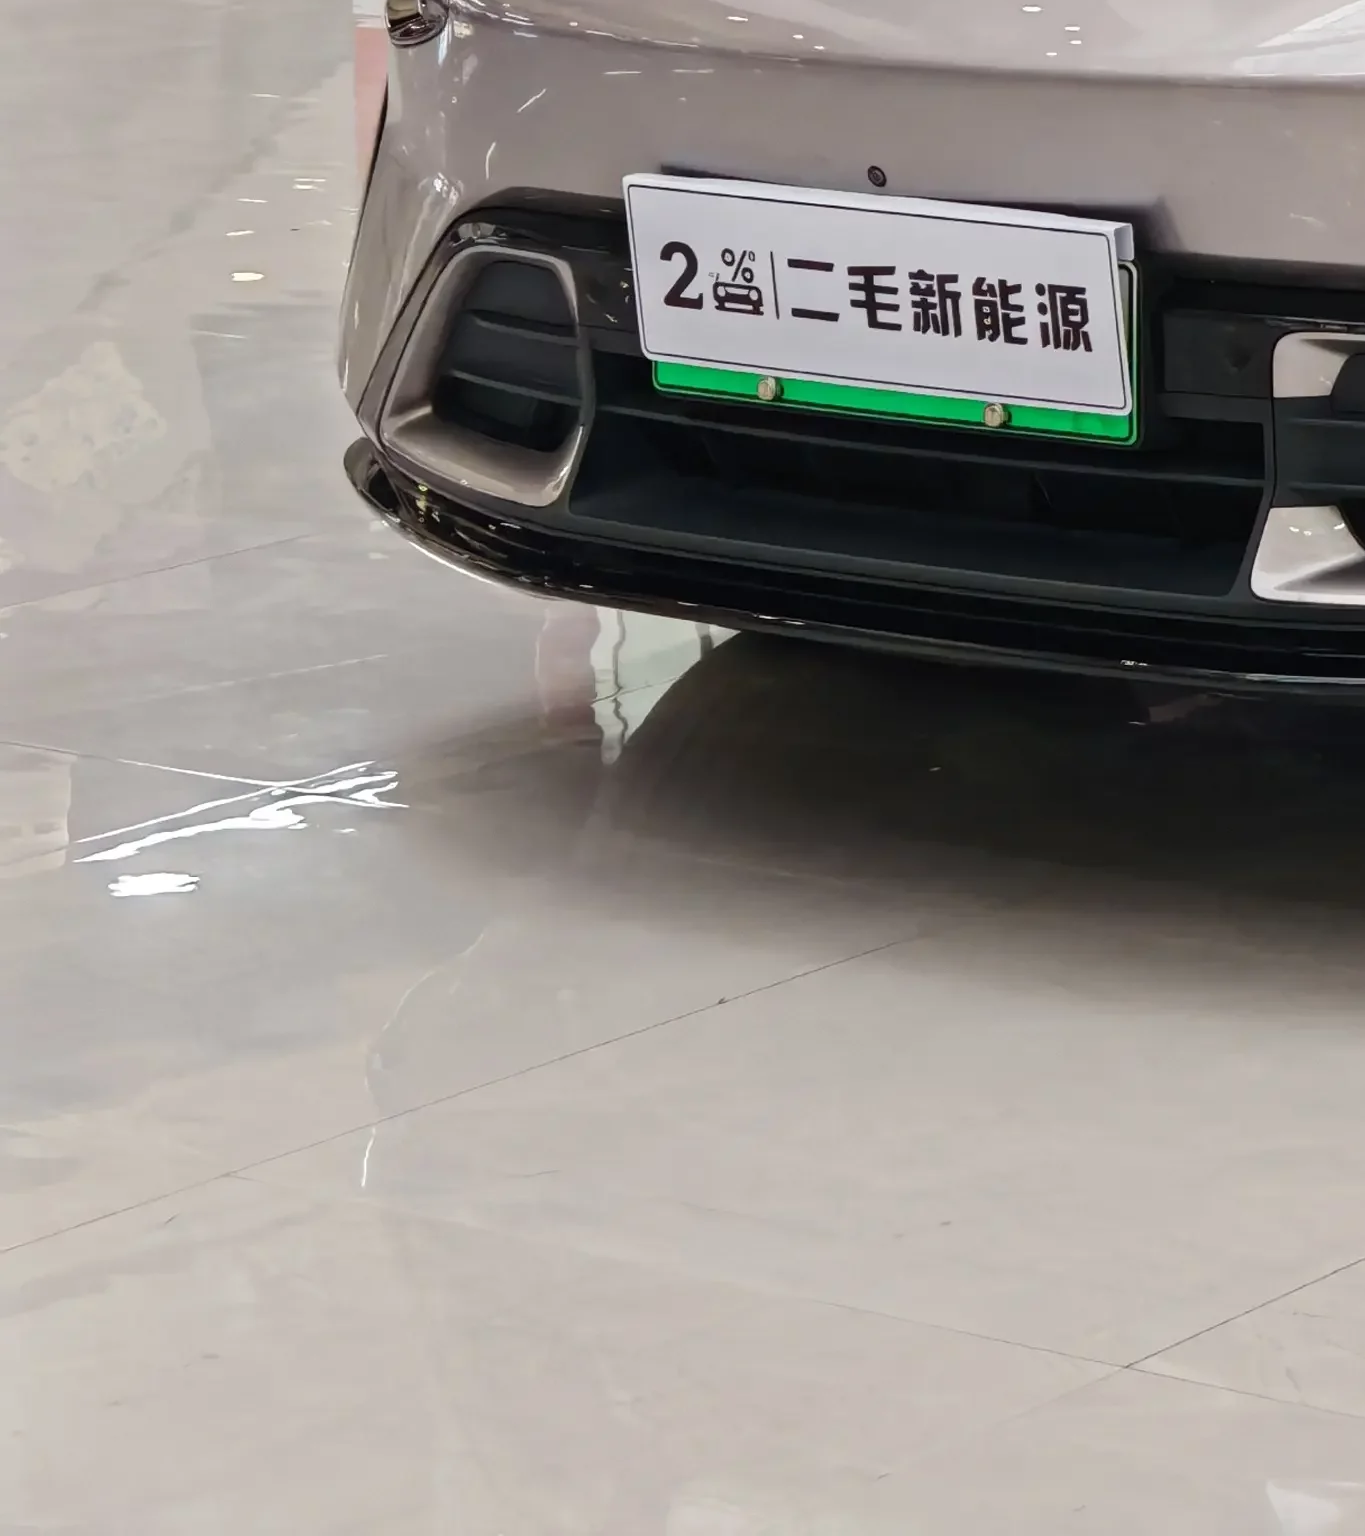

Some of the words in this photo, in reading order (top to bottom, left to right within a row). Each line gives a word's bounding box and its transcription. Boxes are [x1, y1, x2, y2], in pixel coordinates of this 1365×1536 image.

[787, 257, 1093, 353] 二毛新能源
